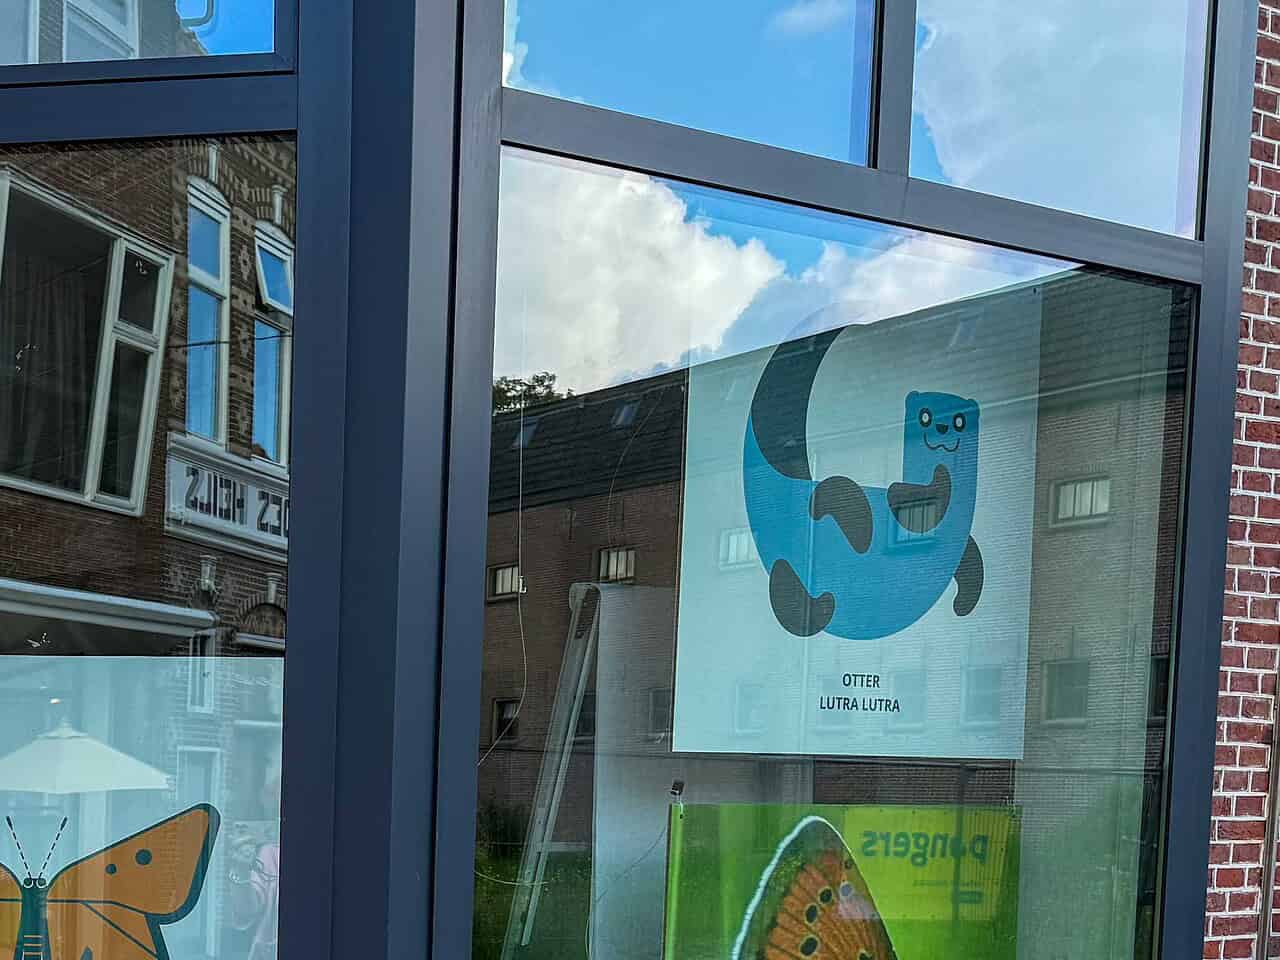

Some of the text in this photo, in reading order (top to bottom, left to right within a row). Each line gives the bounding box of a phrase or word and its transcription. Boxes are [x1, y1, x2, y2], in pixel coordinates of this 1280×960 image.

[842, 672, 880, 688] OTTER
[819, 695, 900, 712] LUTRA LUTRA
